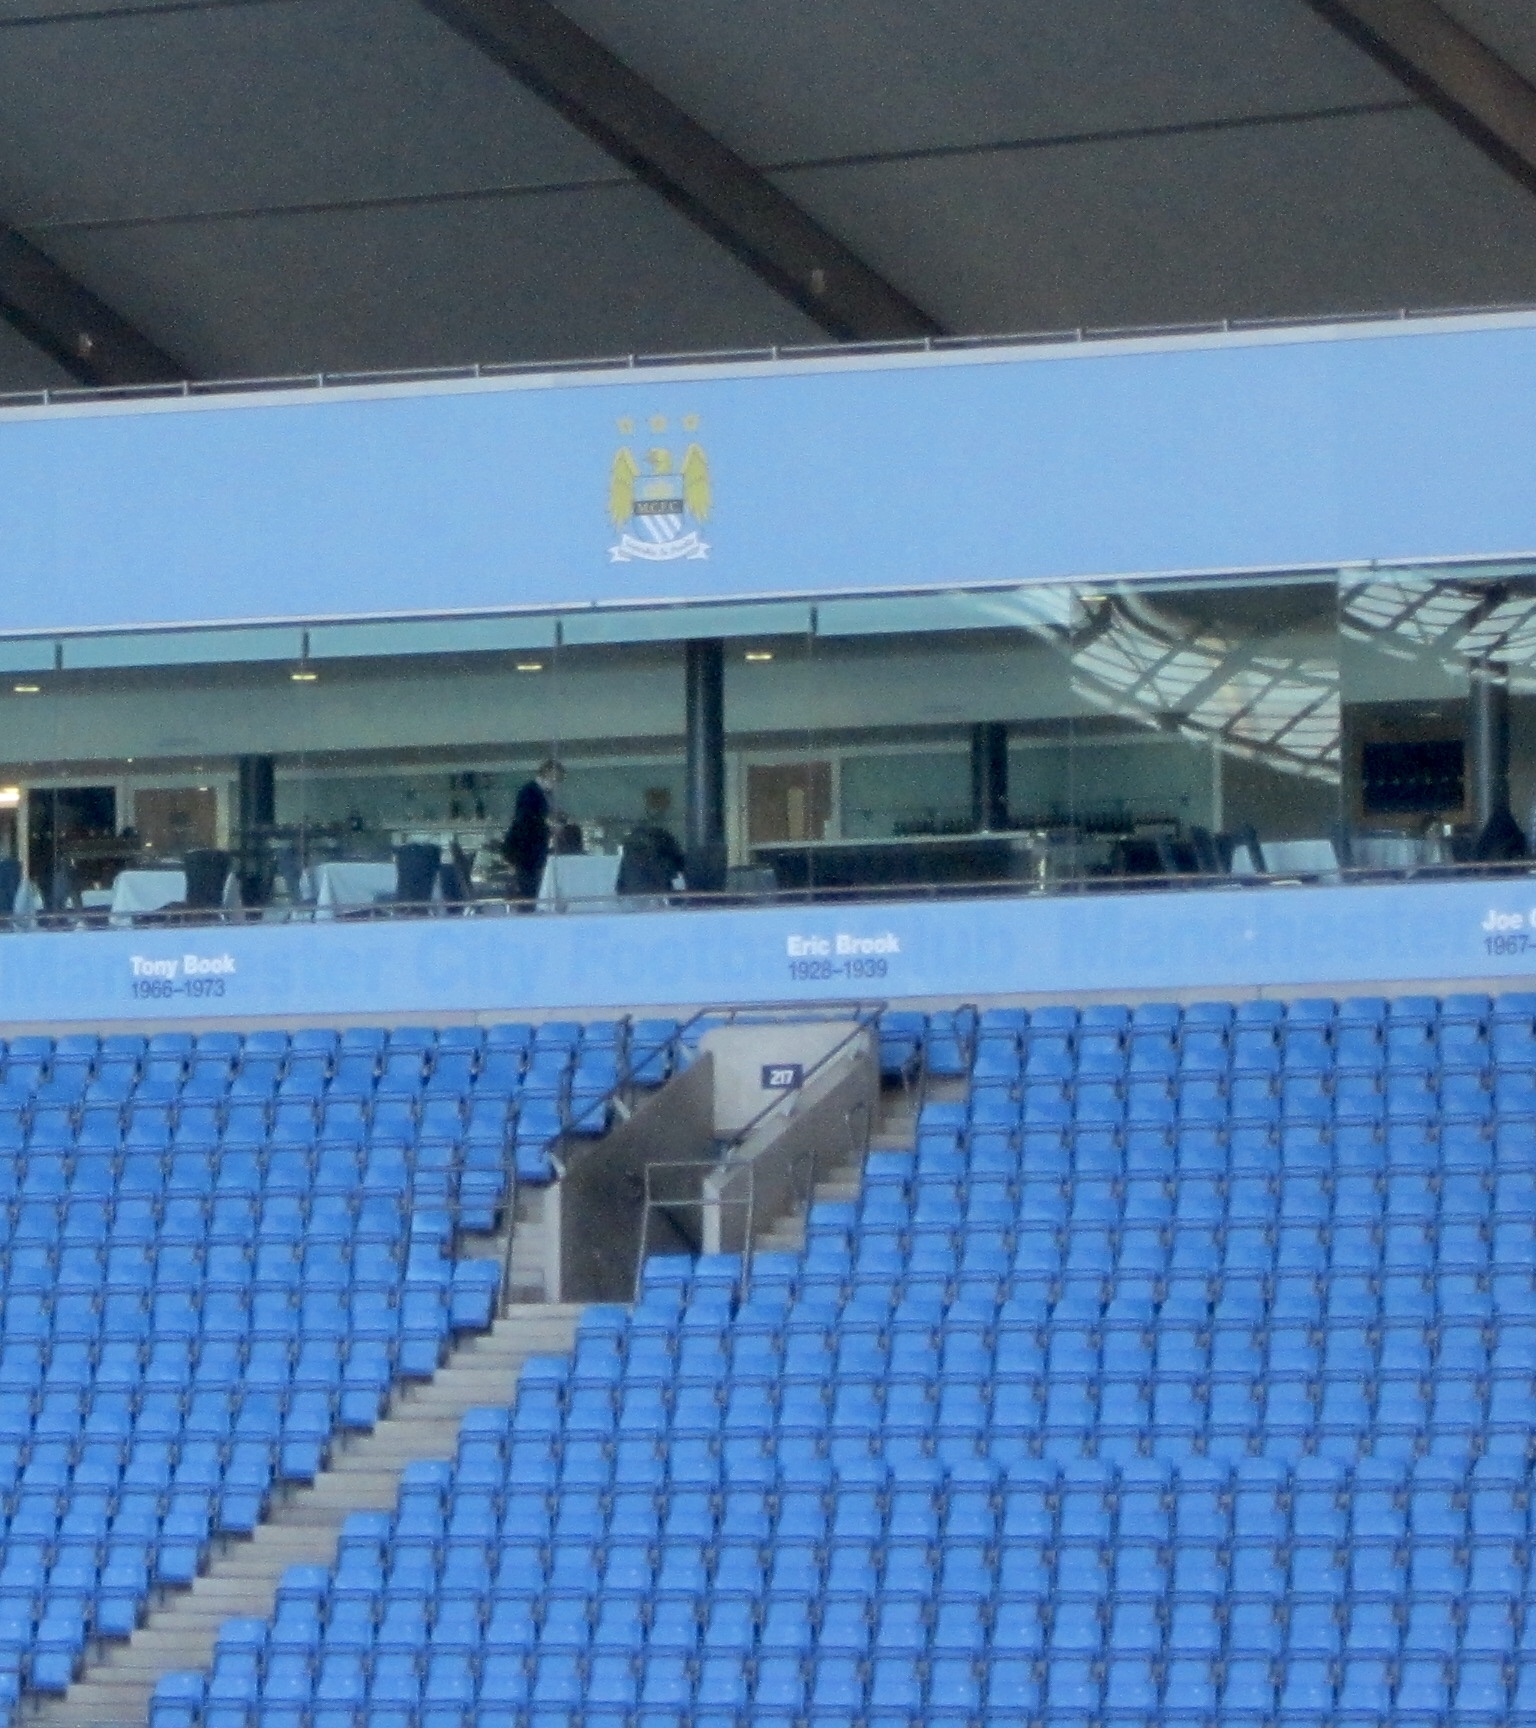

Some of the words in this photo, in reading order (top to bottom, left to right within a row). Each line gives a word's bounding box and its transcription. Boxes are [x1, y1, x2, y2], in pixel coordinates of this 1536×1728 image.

[787, 935, 831, 957] Eric
[836, 932, 901, 955] Brook
[130, 956, 177, 978] Tony
[183, 954, 236, 974] Book
